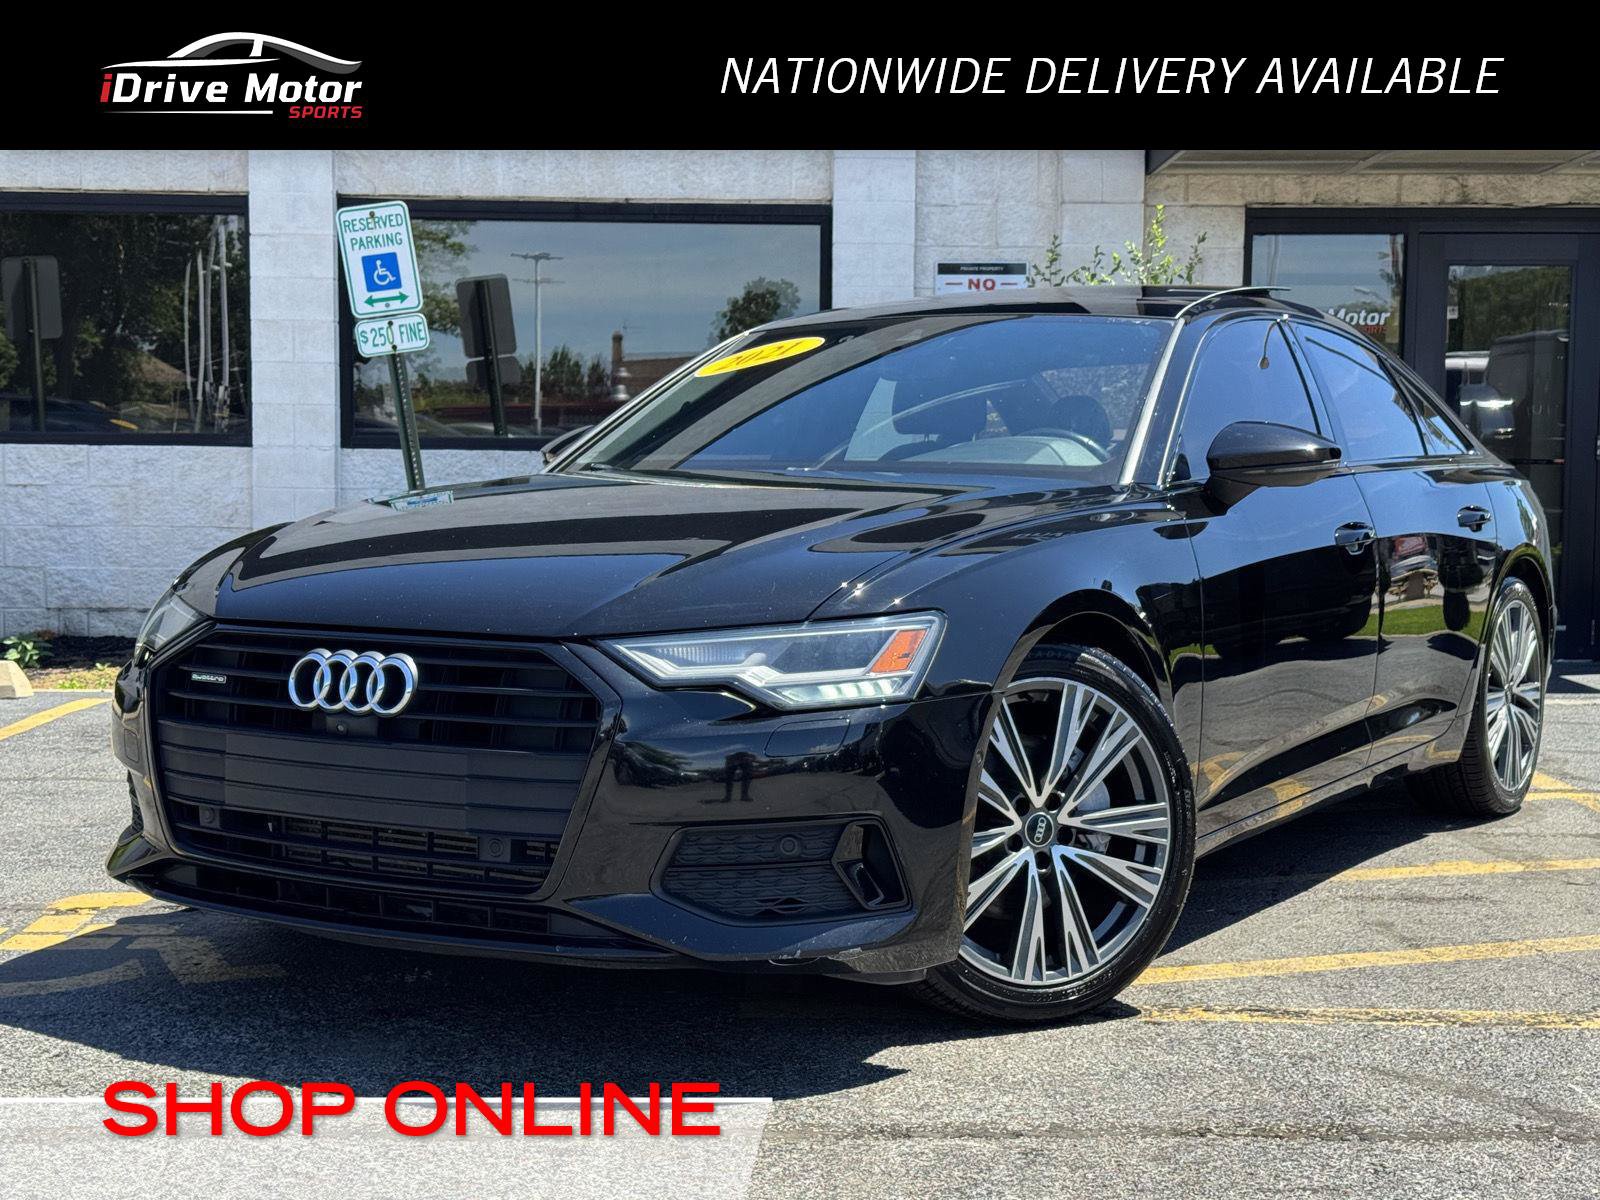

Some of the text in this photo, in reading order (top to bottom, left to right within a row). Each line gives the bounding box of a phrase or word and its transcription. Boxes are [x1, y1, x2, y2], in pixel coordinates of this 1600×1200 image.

[342, 213, 404, 234] RESERVED
[351, 232, 403, 250] PARKING
[968, 278, 996, 291] NO
[399, 322, 425, 343] FINE
